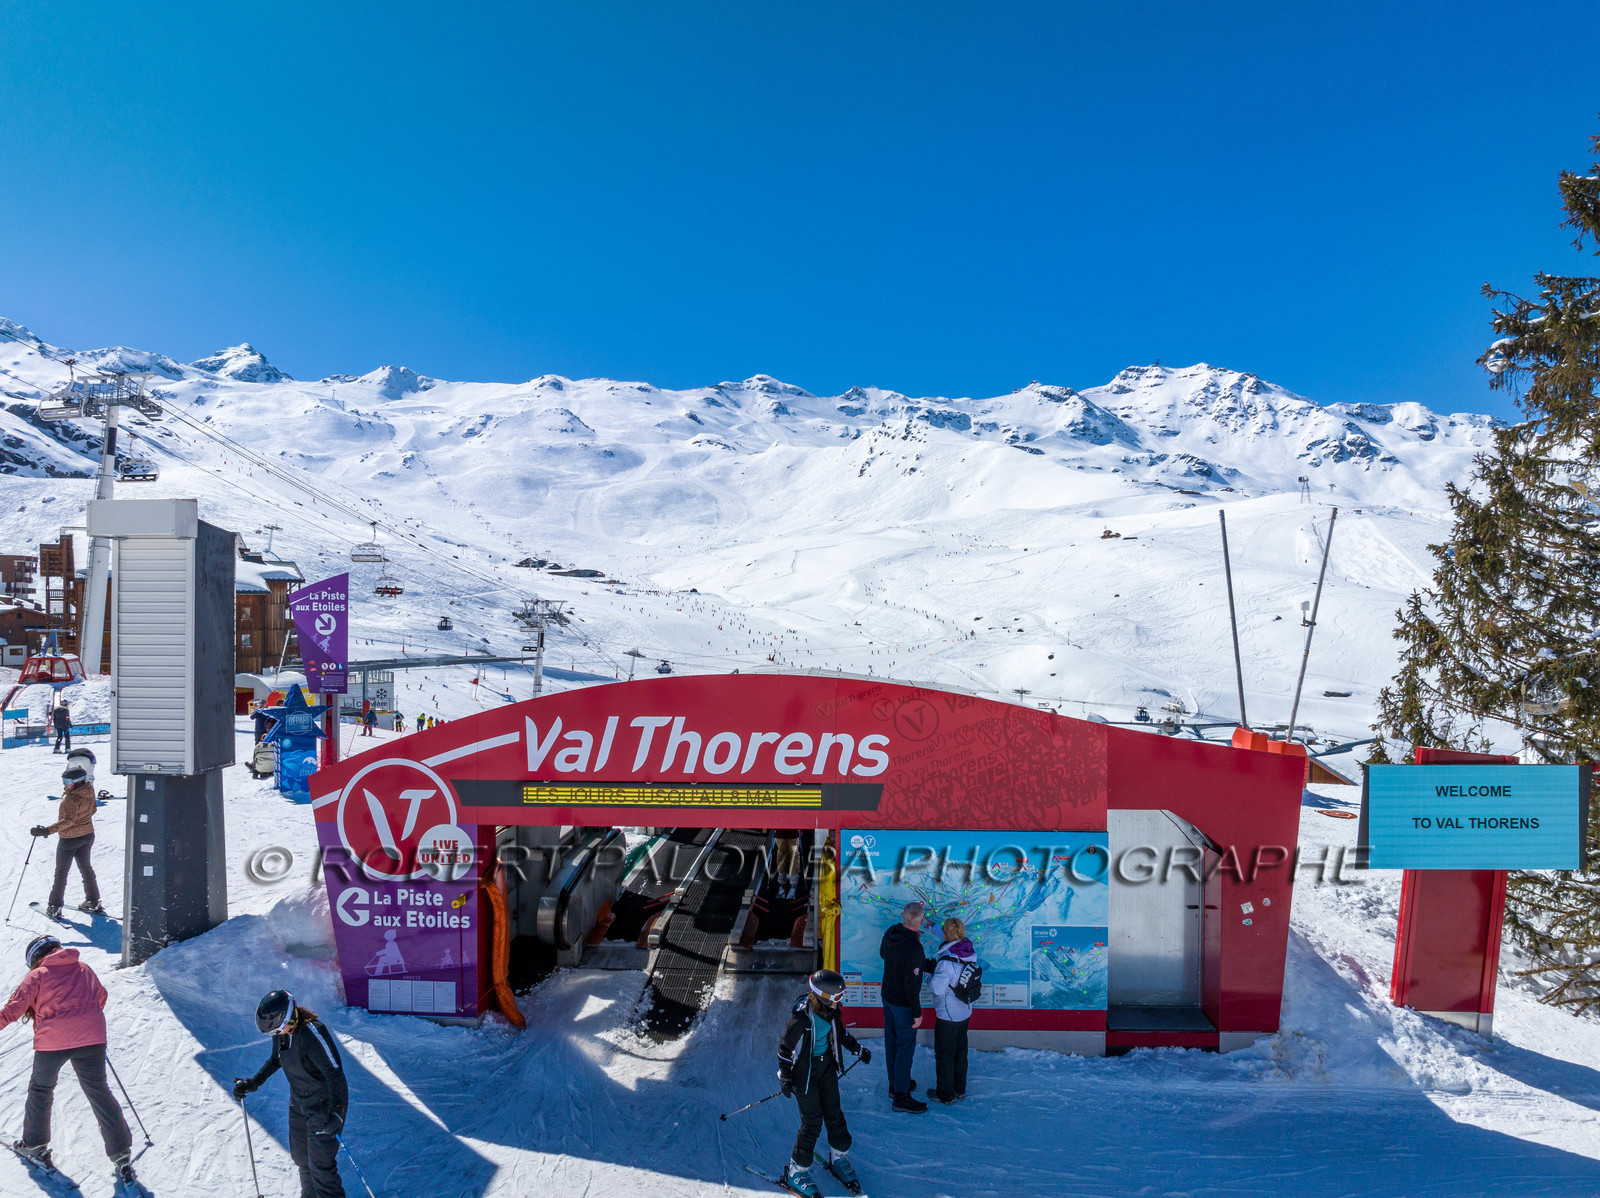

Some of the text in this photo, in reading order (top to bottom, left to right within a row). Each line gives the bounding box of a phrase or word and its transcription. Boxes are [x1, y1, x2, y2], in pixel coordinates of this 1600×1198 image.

[308, 587, 346, 601] La Piste
[295, 601, 346, 612] aux Etoiles
[525, 716, 890, 777] Val Thorens
[1435, 785, 1512, 797] WELCOME
[1412, 817, 1540, 829] TO VAL THORENS
[433, 840, 459, 850] LIVE
[421, 853, 471, 864] UNITED
[373, 888, 444, 906] La Piste
[373, 911, 471, 929] aux Etoiles
[959, 963, 976, 989] JUST
